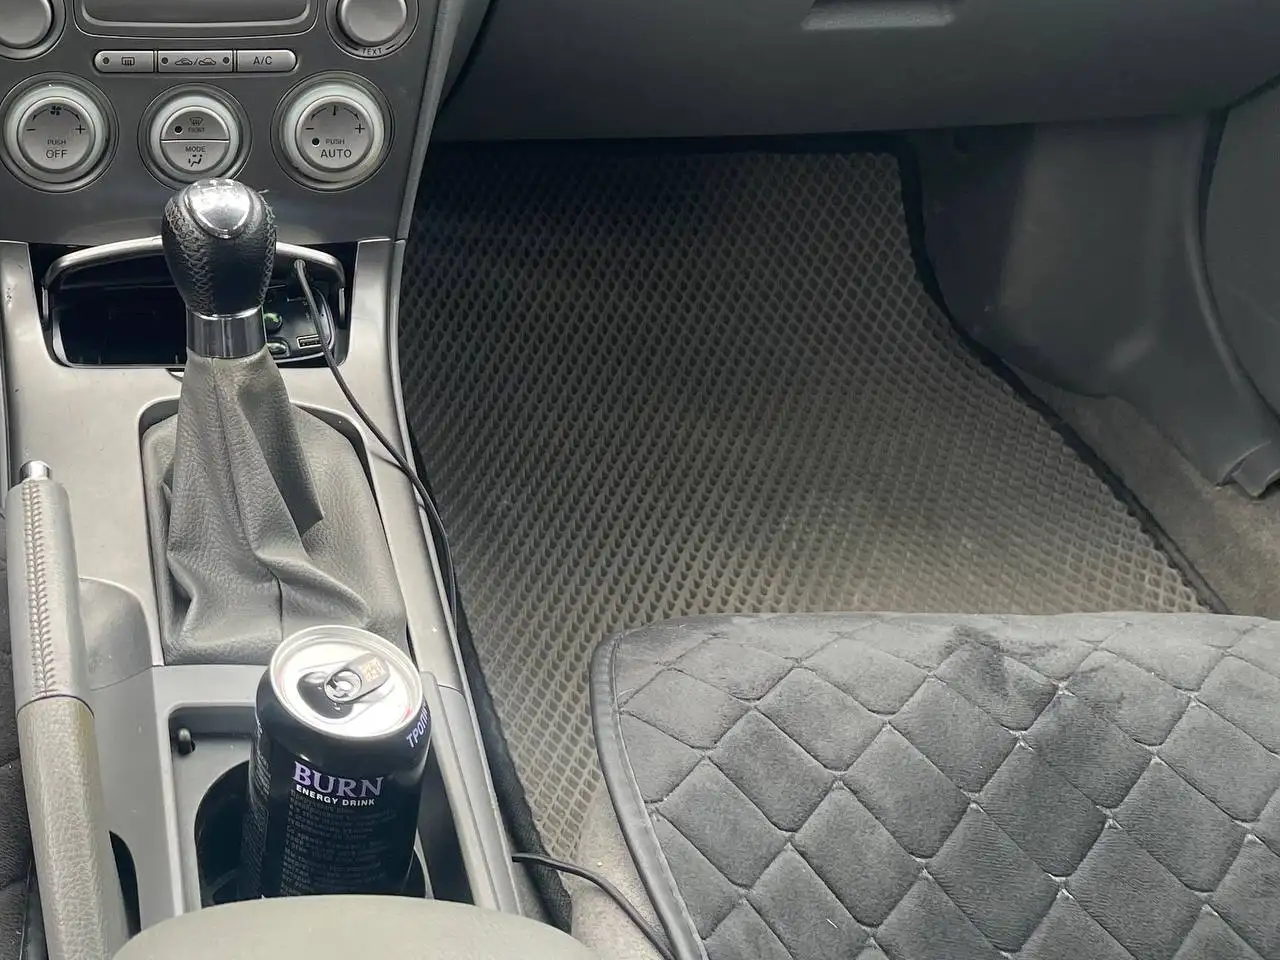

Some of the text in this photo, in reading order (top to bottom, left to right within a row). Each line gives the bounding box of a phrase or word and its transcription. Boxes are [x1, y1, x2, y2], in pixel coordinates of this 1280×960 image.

[362, 48, 382, 56] TEXT
[253, 56, 273, 65] A/C
[46, 149, 68, 158] OFF
[320, 149, 352, 158] AUTO
[292, 760, 385, 798] BURN
[296, 784, 375, 807] ENERGY DRINK
